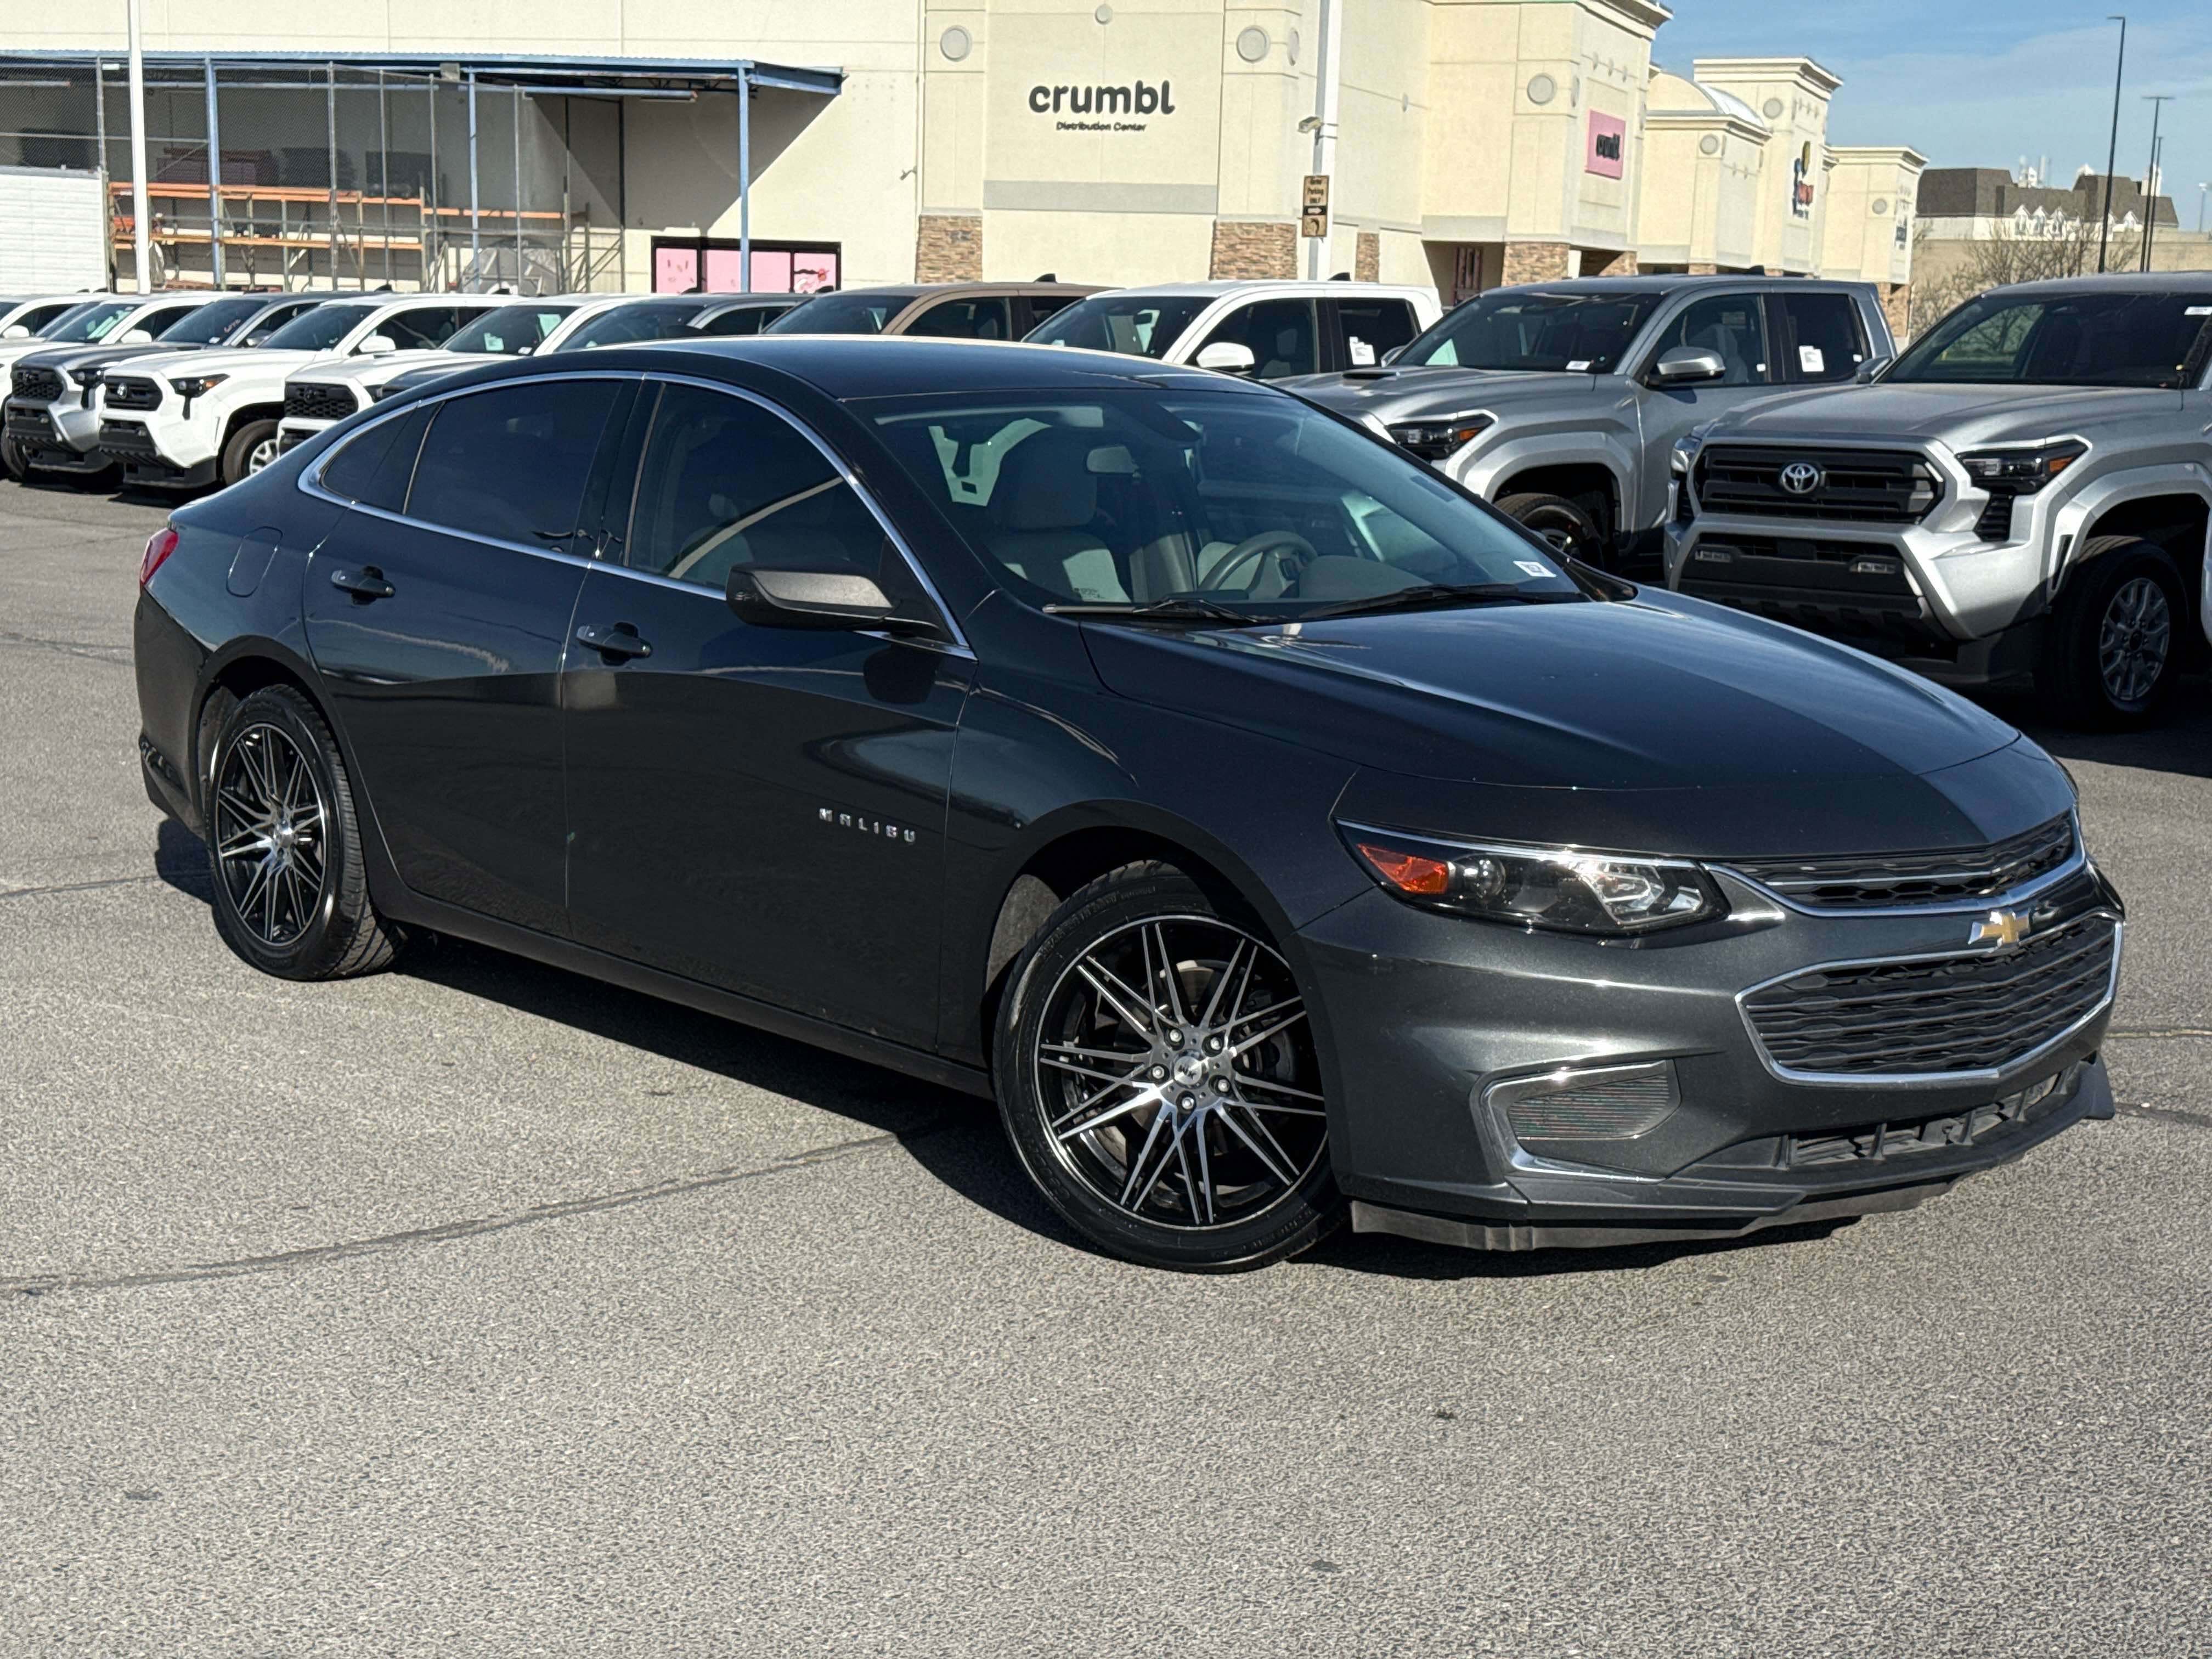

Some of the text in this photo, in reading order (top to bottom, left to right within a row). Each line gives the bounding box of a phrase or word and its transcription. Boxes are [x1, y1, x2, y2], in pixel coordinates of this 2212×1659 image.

[1029, 80, 1175, 115] crumbl
[1056, 121, 1147, 131] Distribution Center
[819, 808, 916, 843] MALIBU
